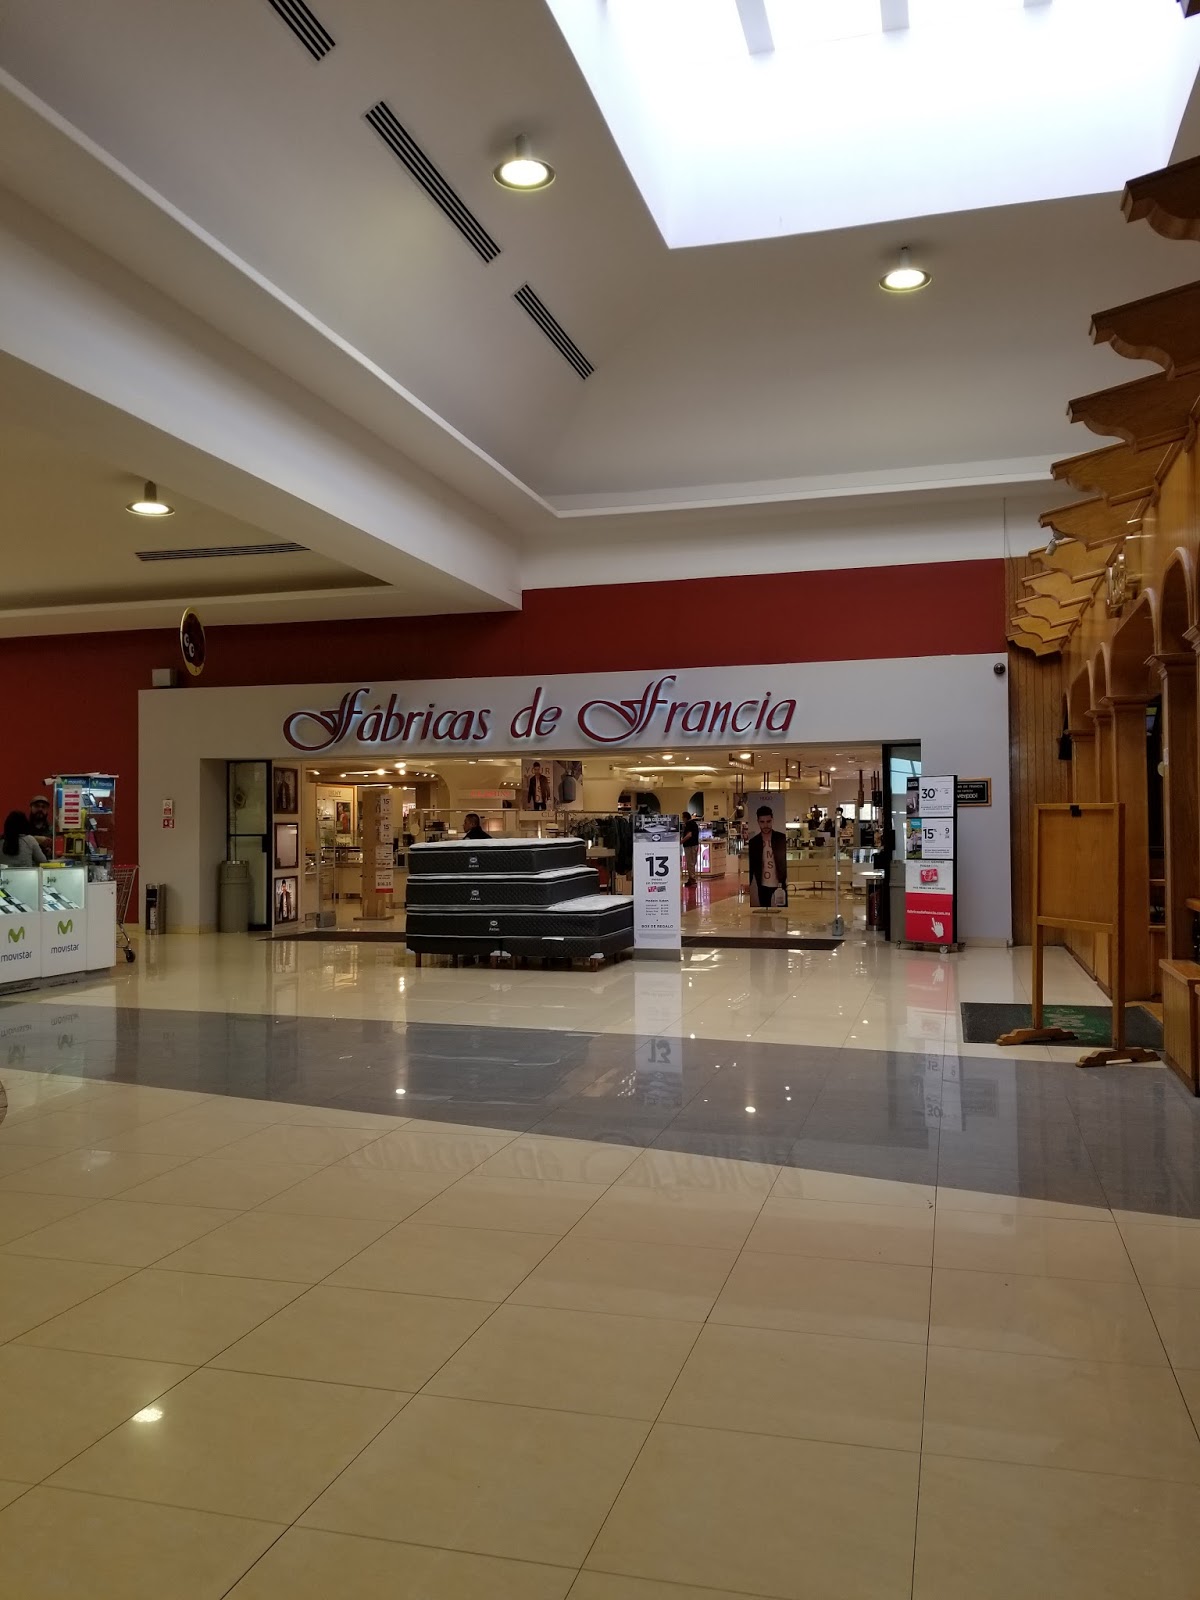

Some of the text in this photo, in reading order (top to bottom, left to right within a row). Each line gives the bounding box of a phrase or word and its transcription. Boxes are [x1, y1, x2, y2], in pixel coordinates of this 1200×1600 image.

[283, 675, 797, 751] Fábricas de Francia
[645, 856, 669, 876] 13
[51, 943, 80, 954] movistar
[1, 951, 33, 962] movistar
